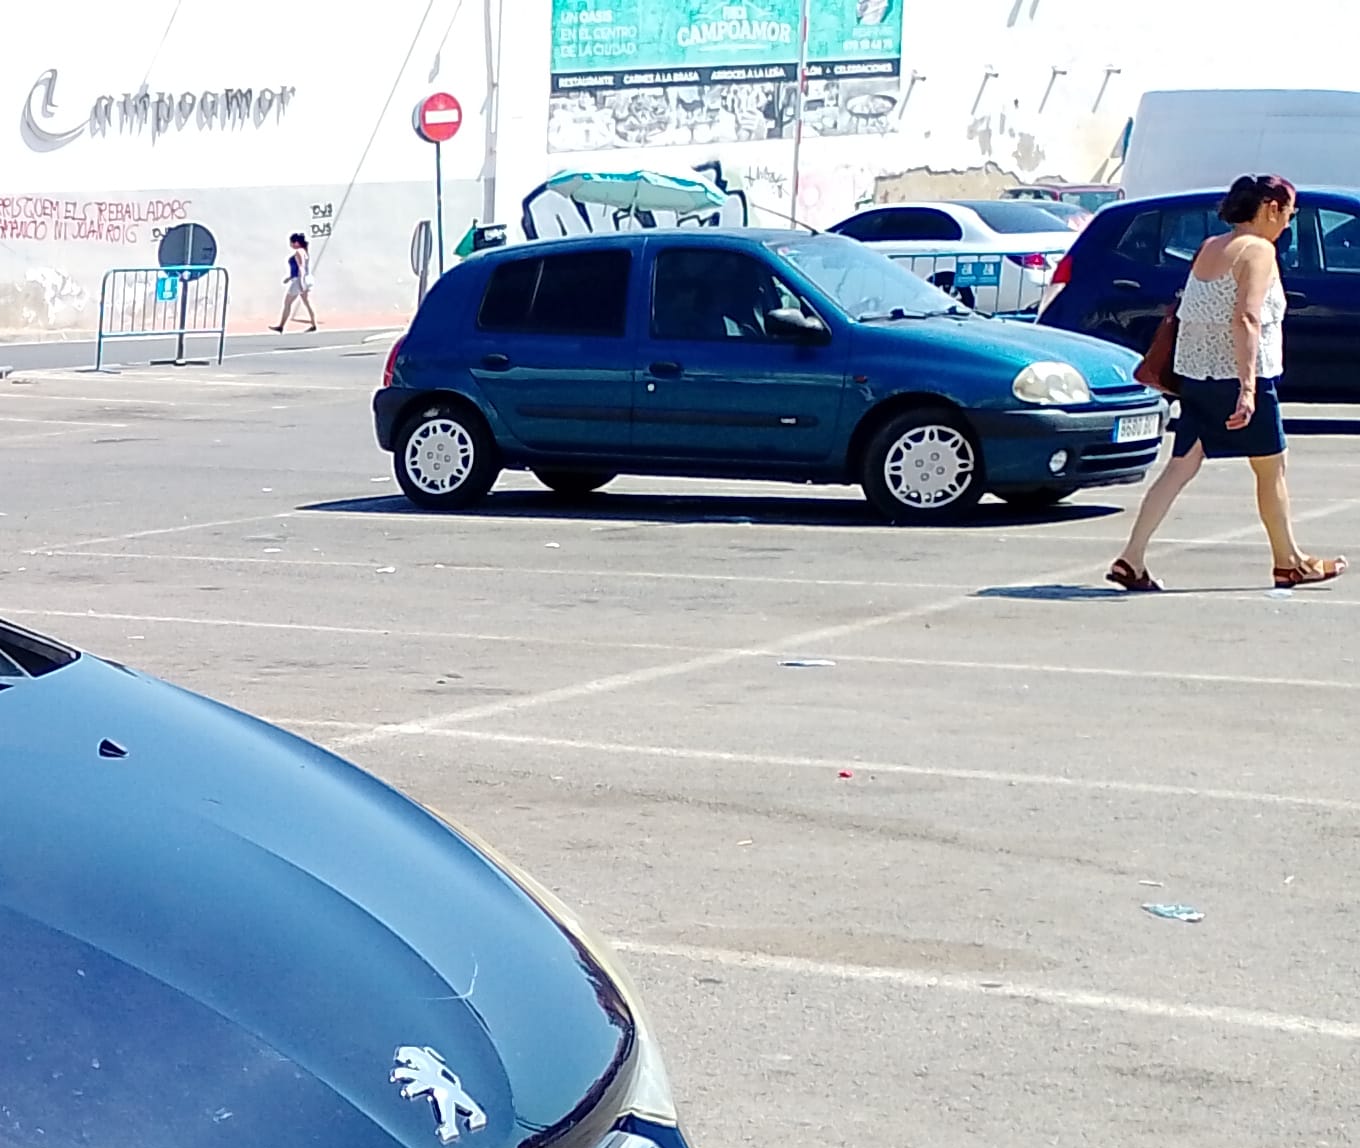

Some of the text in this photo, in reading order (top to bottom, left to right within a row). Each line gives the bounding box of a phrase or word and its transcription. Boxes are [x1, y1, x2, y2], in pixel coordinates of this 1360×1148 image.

[579, 10, 613, 23] OASIS
[561, 28, 577, 41] EN
[593, 26, 638, 40] CENTRO
[677, 20, 792, 46] CAMPOAMOR
[579, 42, 592, 57] LA
[593, 42, 637, 56] CIUDAD
